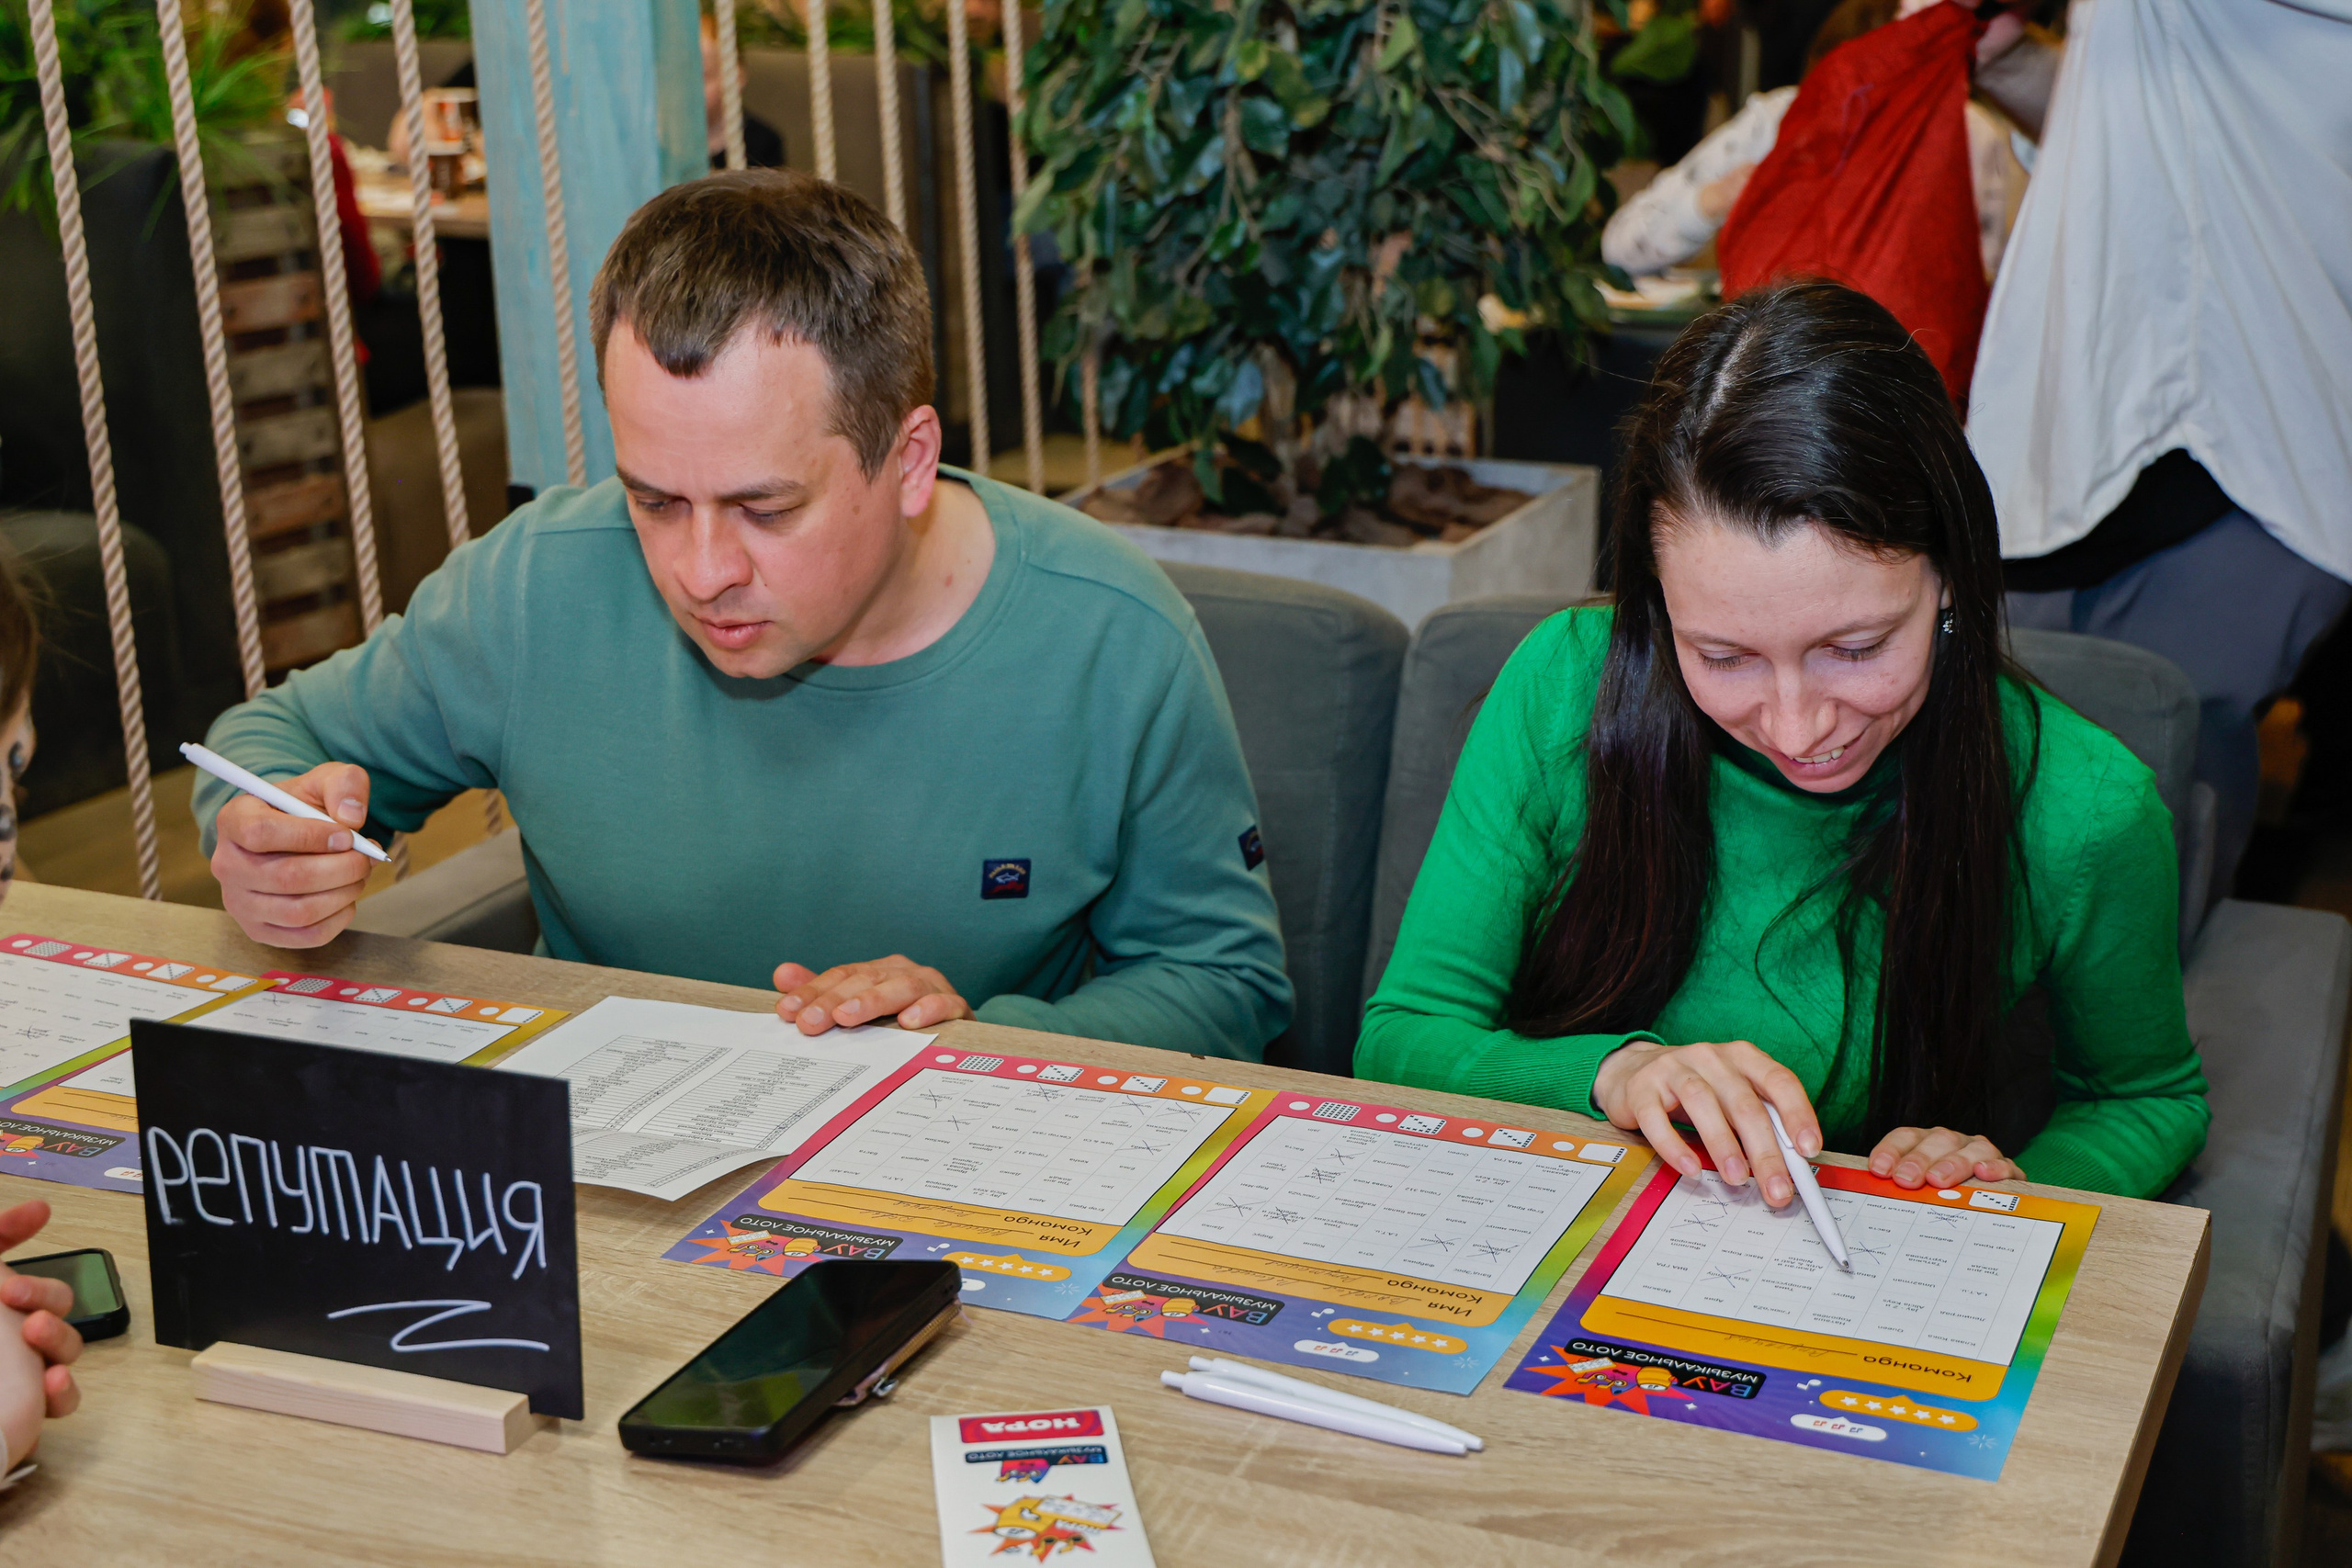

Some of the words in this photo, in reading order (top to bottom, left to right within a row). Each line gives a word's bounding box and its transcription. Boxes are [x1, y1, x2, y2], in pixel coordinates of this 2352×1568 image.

[19, 1125, 117, 1145] МУЗЫКАЛЬНОЕ
[44, 1143, 102, 1156] ВАУ
[740, 1216, 782, 1232] ЛОТО
[1003, 1214, 1092, 1235] Команда
[784, 1223, 895, 1247] МУЗЫКАЛЬНОЕ
[1039, 1235, 1080, 1248] Имя
[824, 1244, 886, 1260] ВАУ
[1112, 1275, 1156, 1292] ЛОТО
[1387, 1280, 1482, 1303] Команда
[1159, 1284, 1277, 1310] МУЗЫКАЛЬНОЕ
[1204, 1303, 1266, 1324] ВАУ
[1428, 1302, 1472, 1317] Имя
[1572, 1342, 1621, 1357] ЛОТО
[1625, 1349, 1758, 1383] МУЗЫКАЛЬНОЕ
[1863, 1354, 1972, 1382] Команда
[1683, 1375, 1751, 1397] ВАУ
